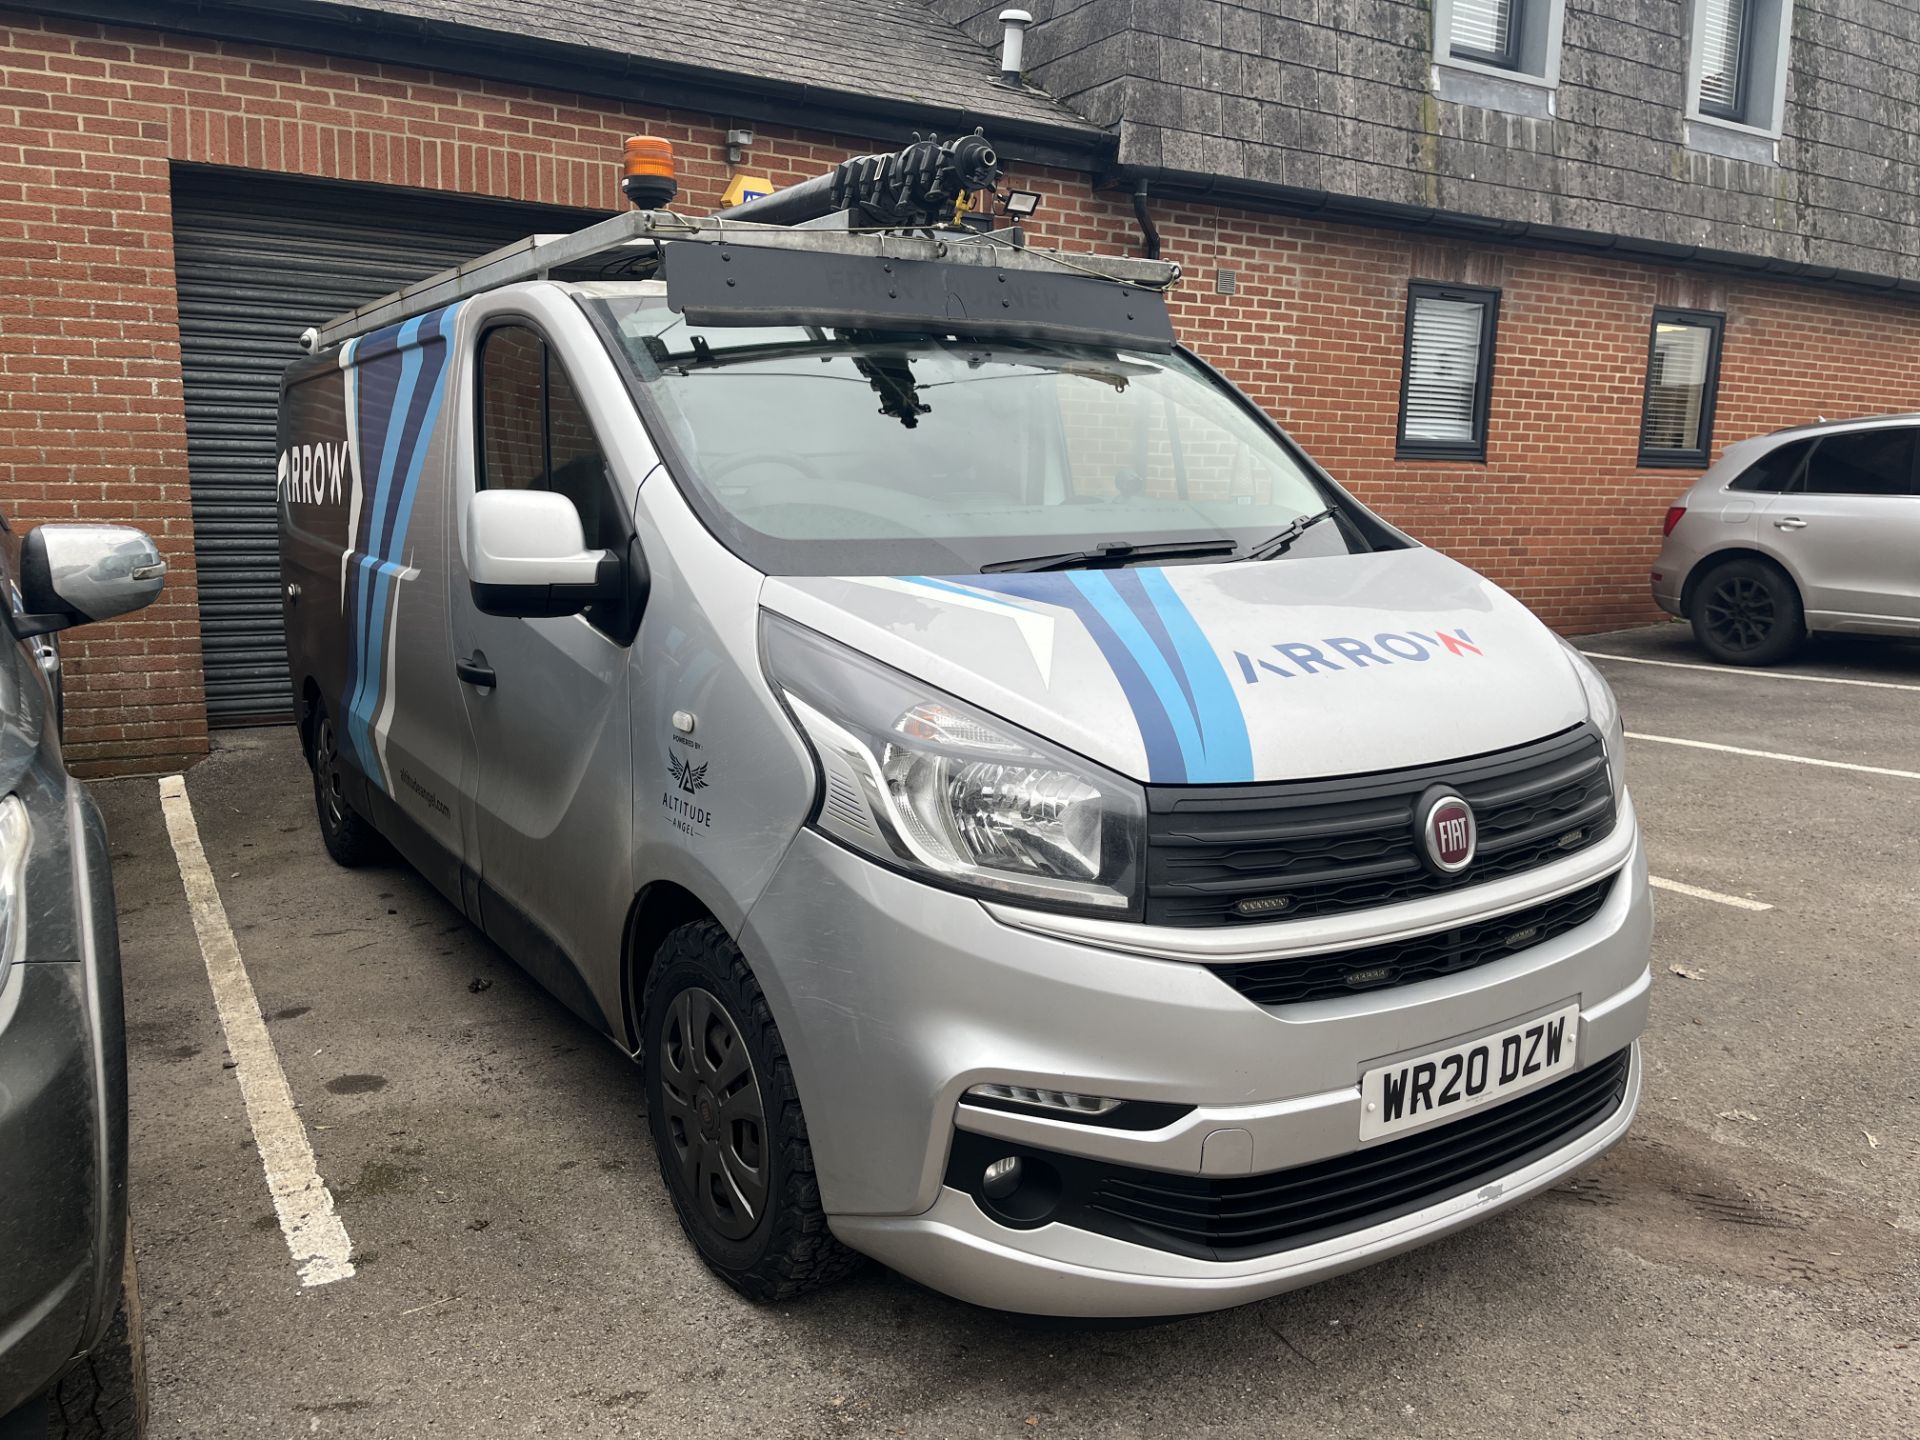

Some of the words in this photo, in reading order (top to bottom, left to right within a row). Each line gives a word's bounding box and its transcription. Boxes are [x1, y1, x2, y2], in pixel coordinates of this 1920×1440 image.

[276, 440, 348, 506] ARROW
[1233, 629, 1484, 684] ARROW
[673, 735, 694, 748] POWERED
[662, 792, 711, 827] ALTITUDE
[673, 818, 694, 836] ANGEL
[1439, 817, 1467, 853] FIAT
[1383, 1045, 1490, 1123] WR20
[1499, 1016, 1565, 1086] DZW
